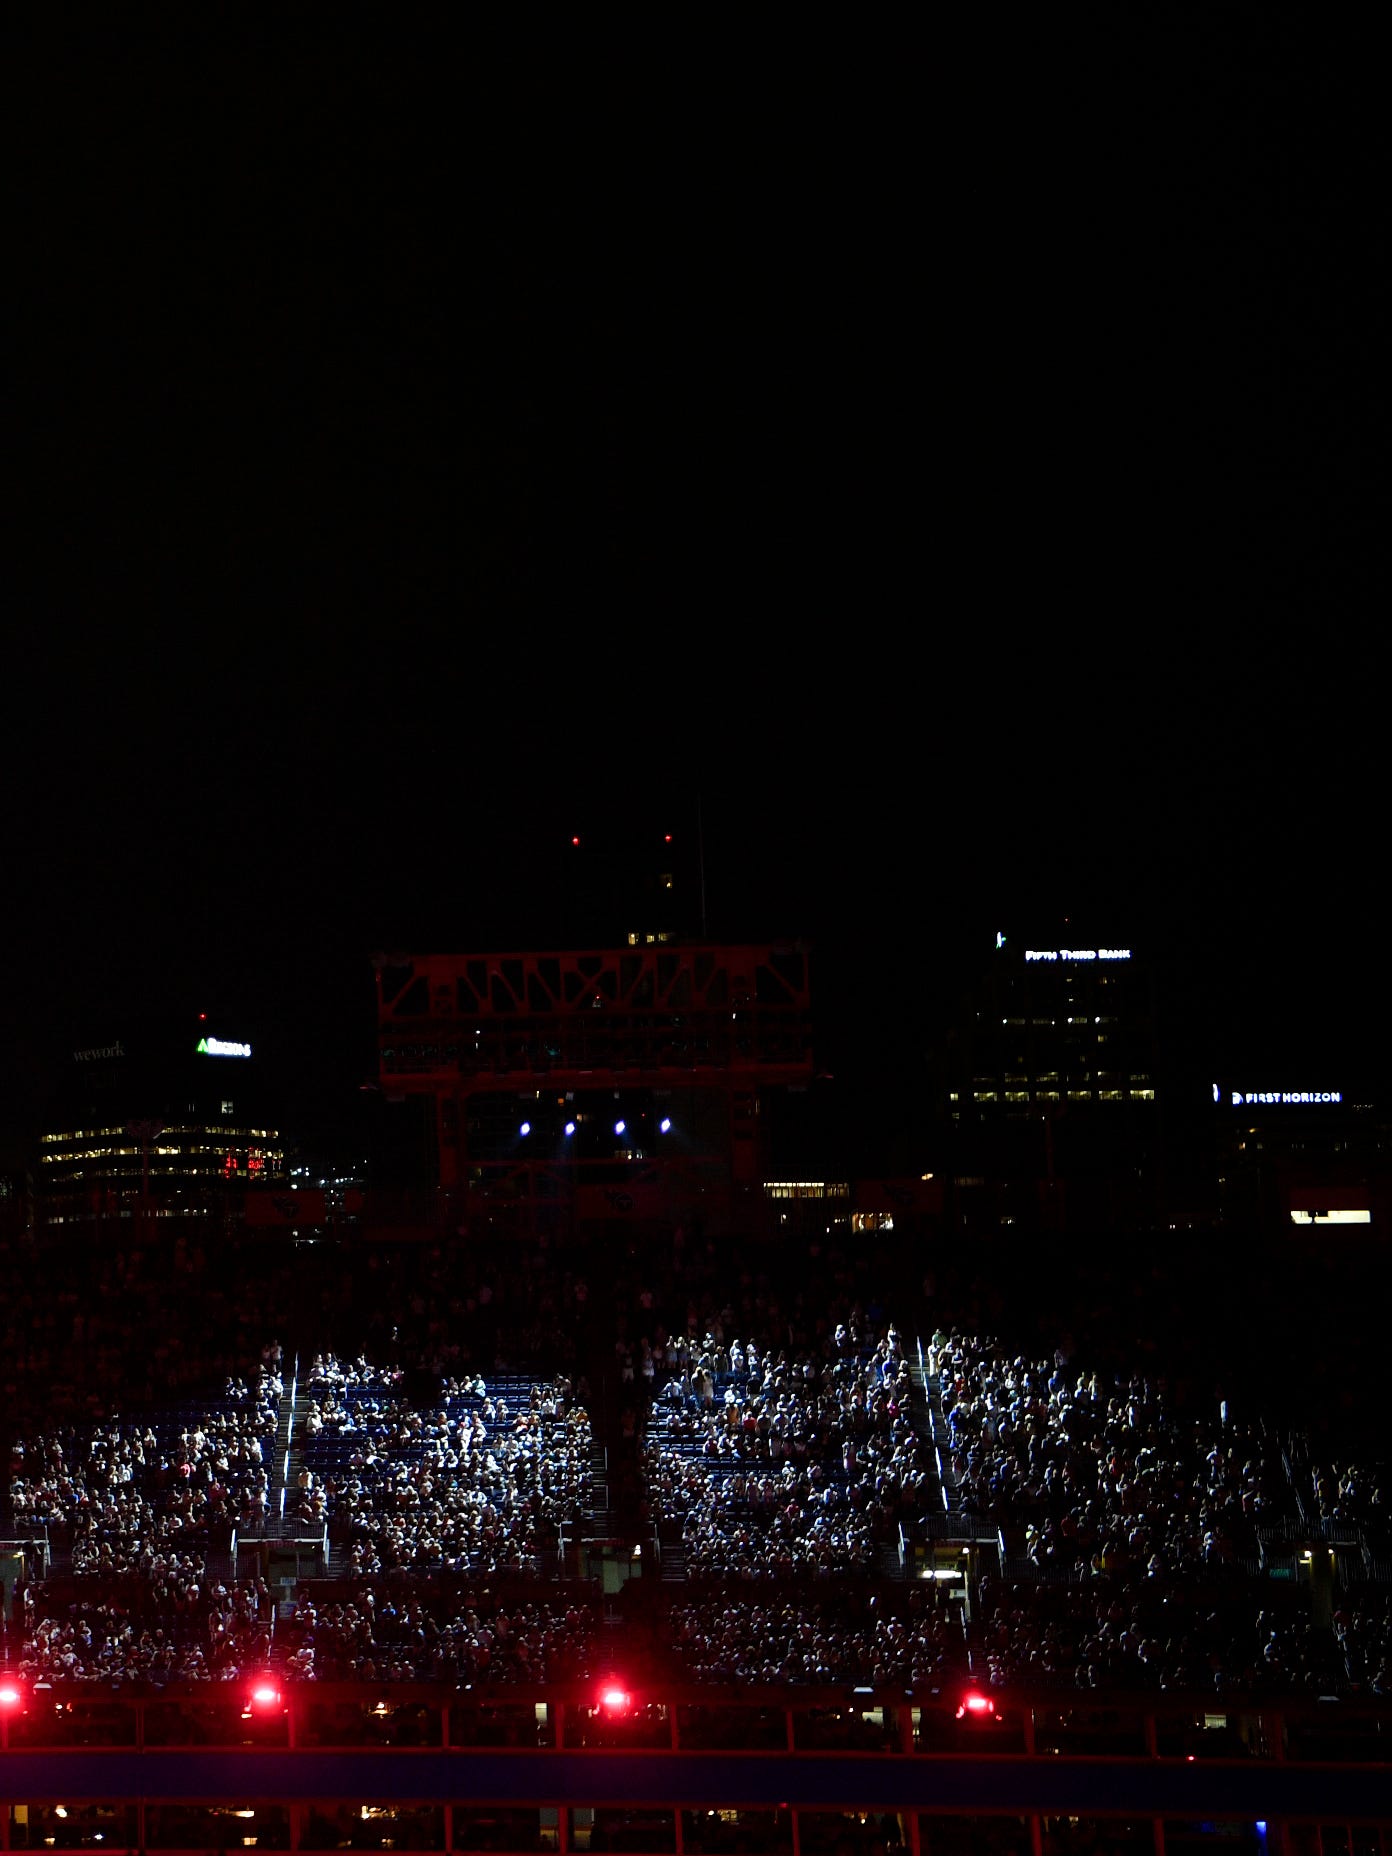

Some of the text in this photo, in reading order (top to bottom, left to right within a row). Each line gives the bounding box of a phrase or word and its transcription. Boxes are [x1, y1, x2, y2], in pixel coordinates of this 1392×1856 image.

[1098, 949, 1131, 959] BANK
[1245, 1092, 1341, 1103] FIRST HORIZON
